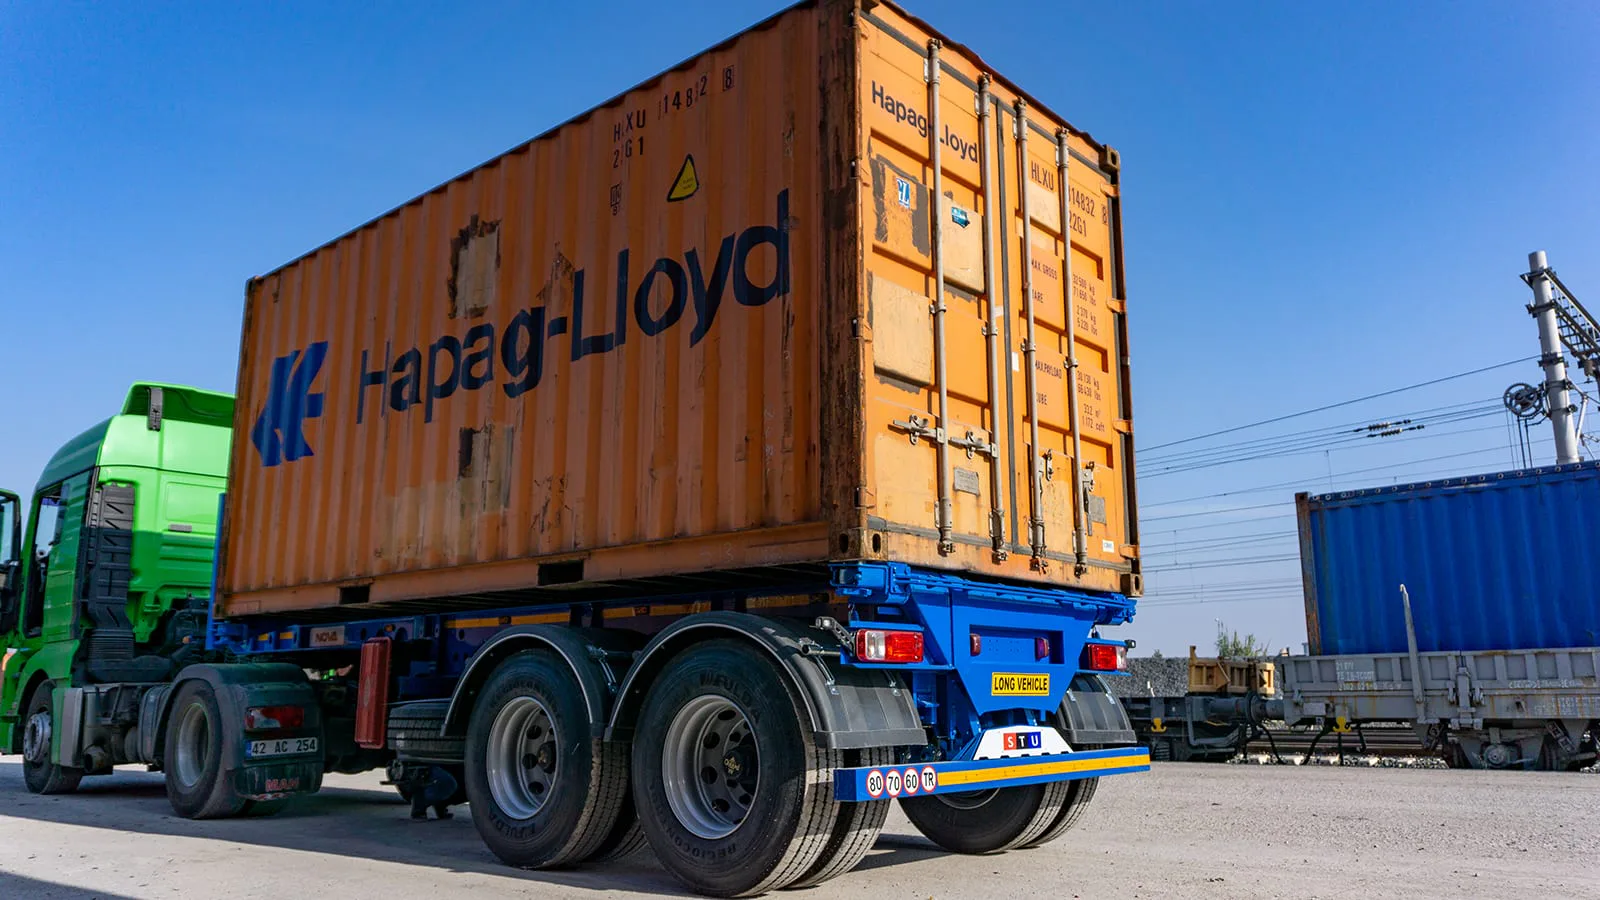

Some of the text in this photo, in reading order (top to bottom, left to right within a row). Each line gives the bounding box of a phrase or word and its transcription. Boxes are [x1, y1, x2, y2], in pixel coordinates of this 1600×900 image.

[1031, 161, 1054, 191] HLXU
[357, 188, 789, 424] Hapag-Lloyd
[994, 676, 1048, 691] LONG VEHICLE
[252, 739, 316, 754] 42 AC 254
[869, 772, 935, 792] 80 70 60 TR
